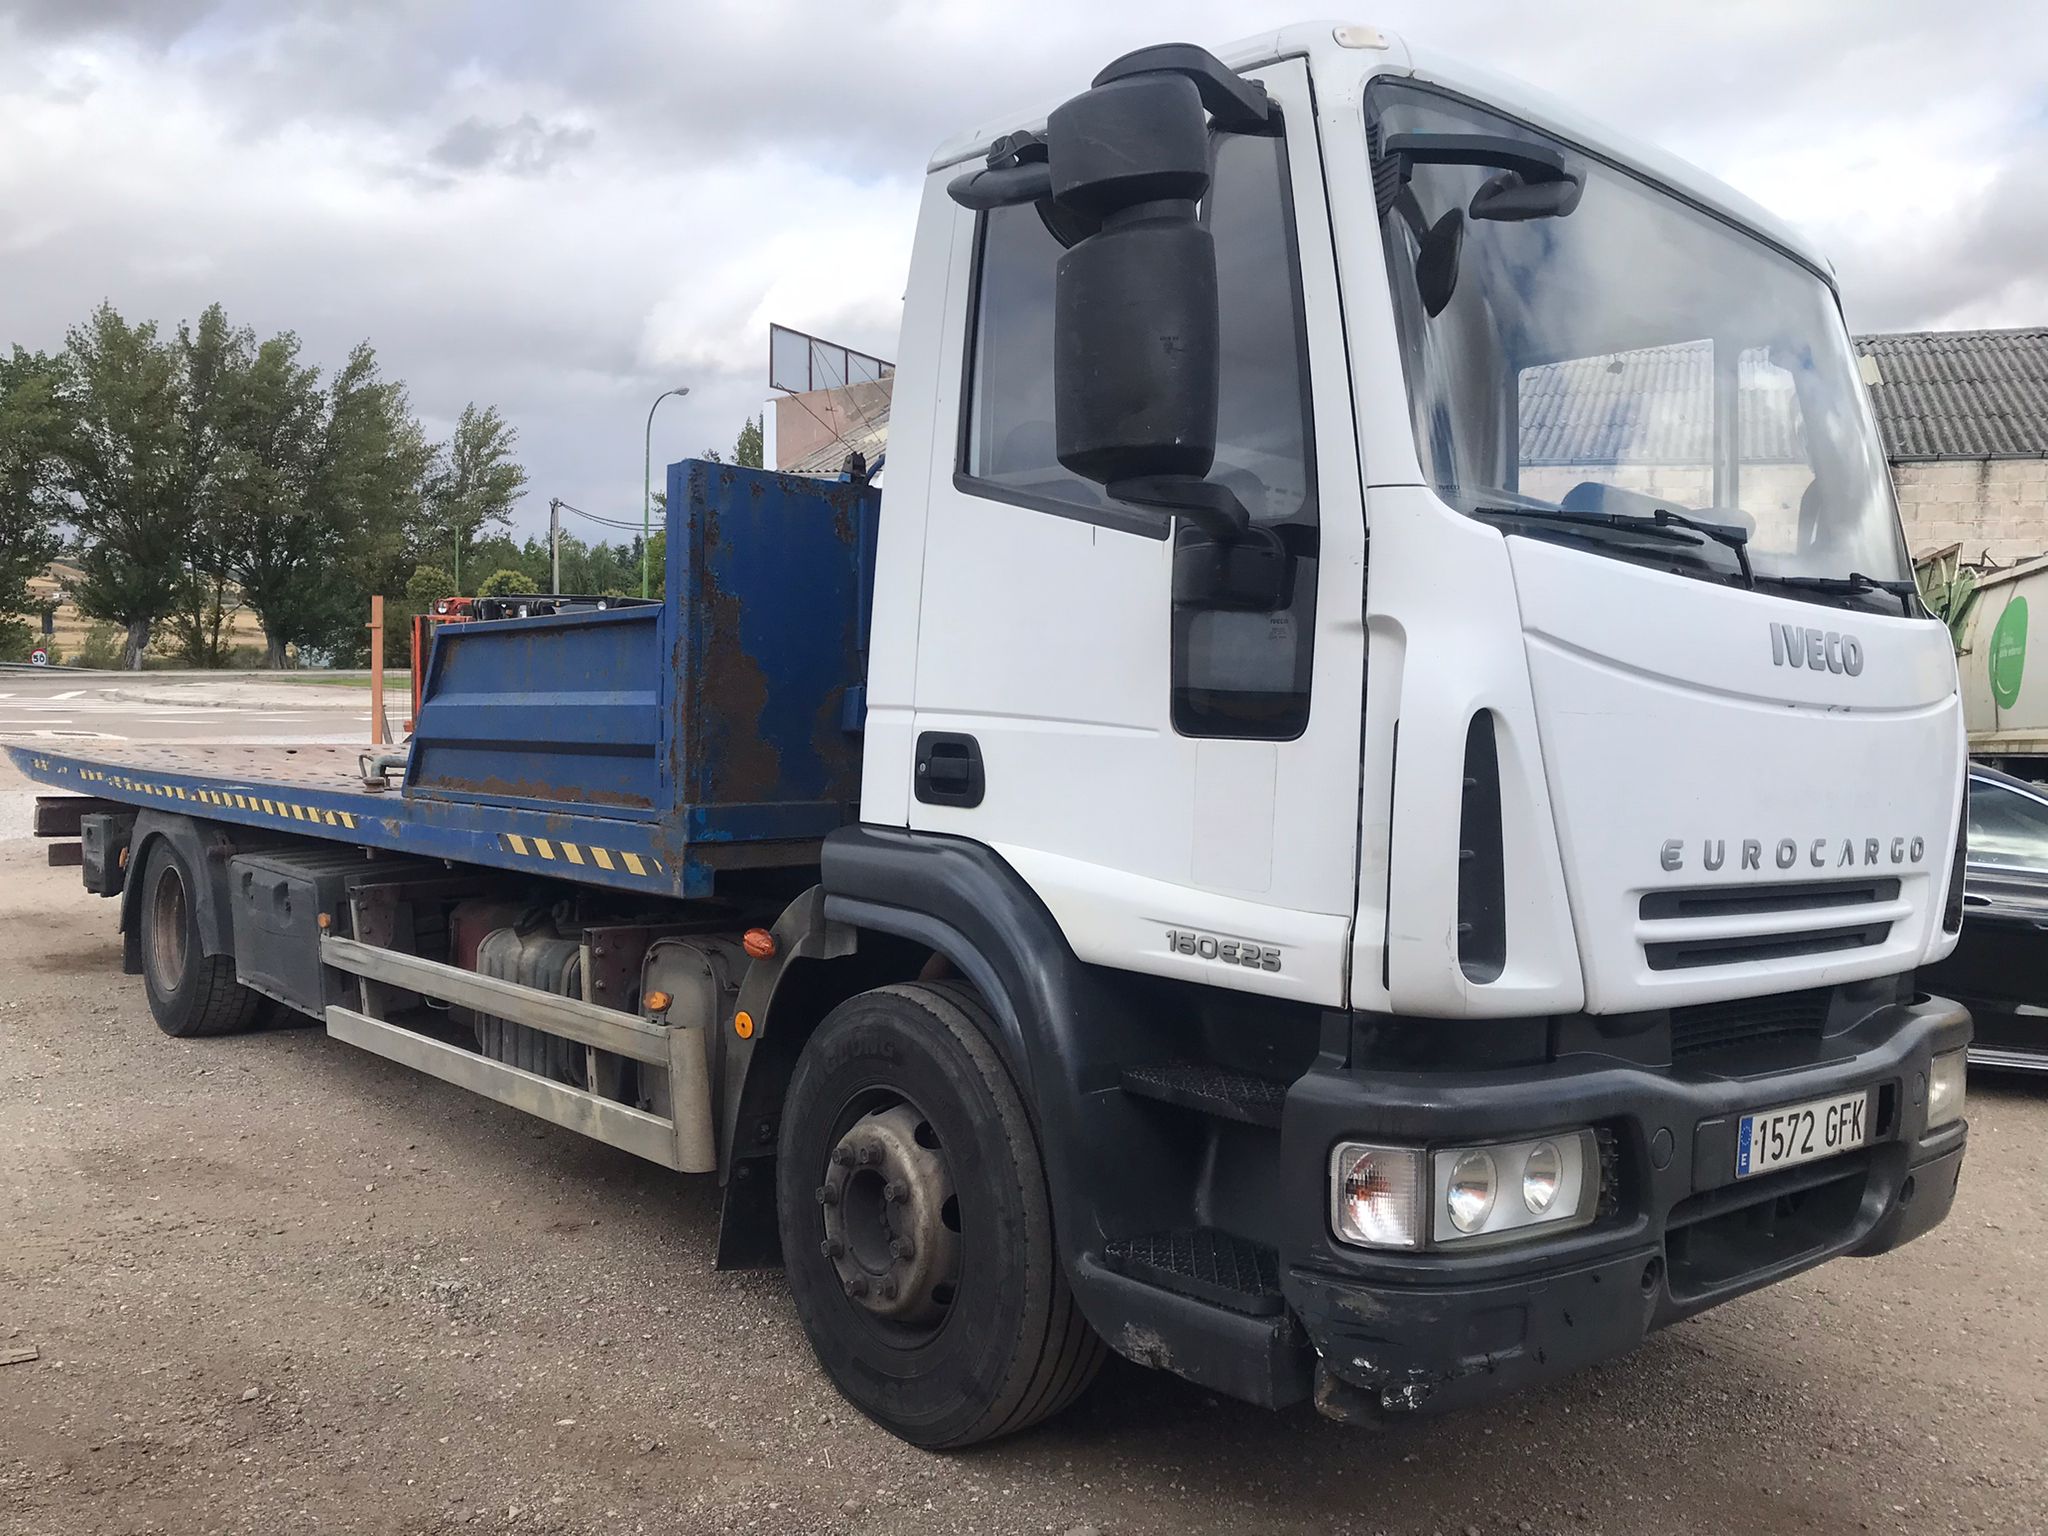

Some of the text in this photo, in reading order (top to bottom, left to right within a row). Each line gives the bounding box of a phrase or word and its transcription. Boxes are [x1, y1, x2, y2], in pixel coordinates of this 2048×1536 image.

[33, 654, 46, 663] 50
[1769, 622, 1864, 677] IVECO
[1661, 836, 1925, 872] EUROCARGO
[1166, 930, 1282, 973] 160E25
[1740, 1099, 1865, 1167] E 1572 GFK
